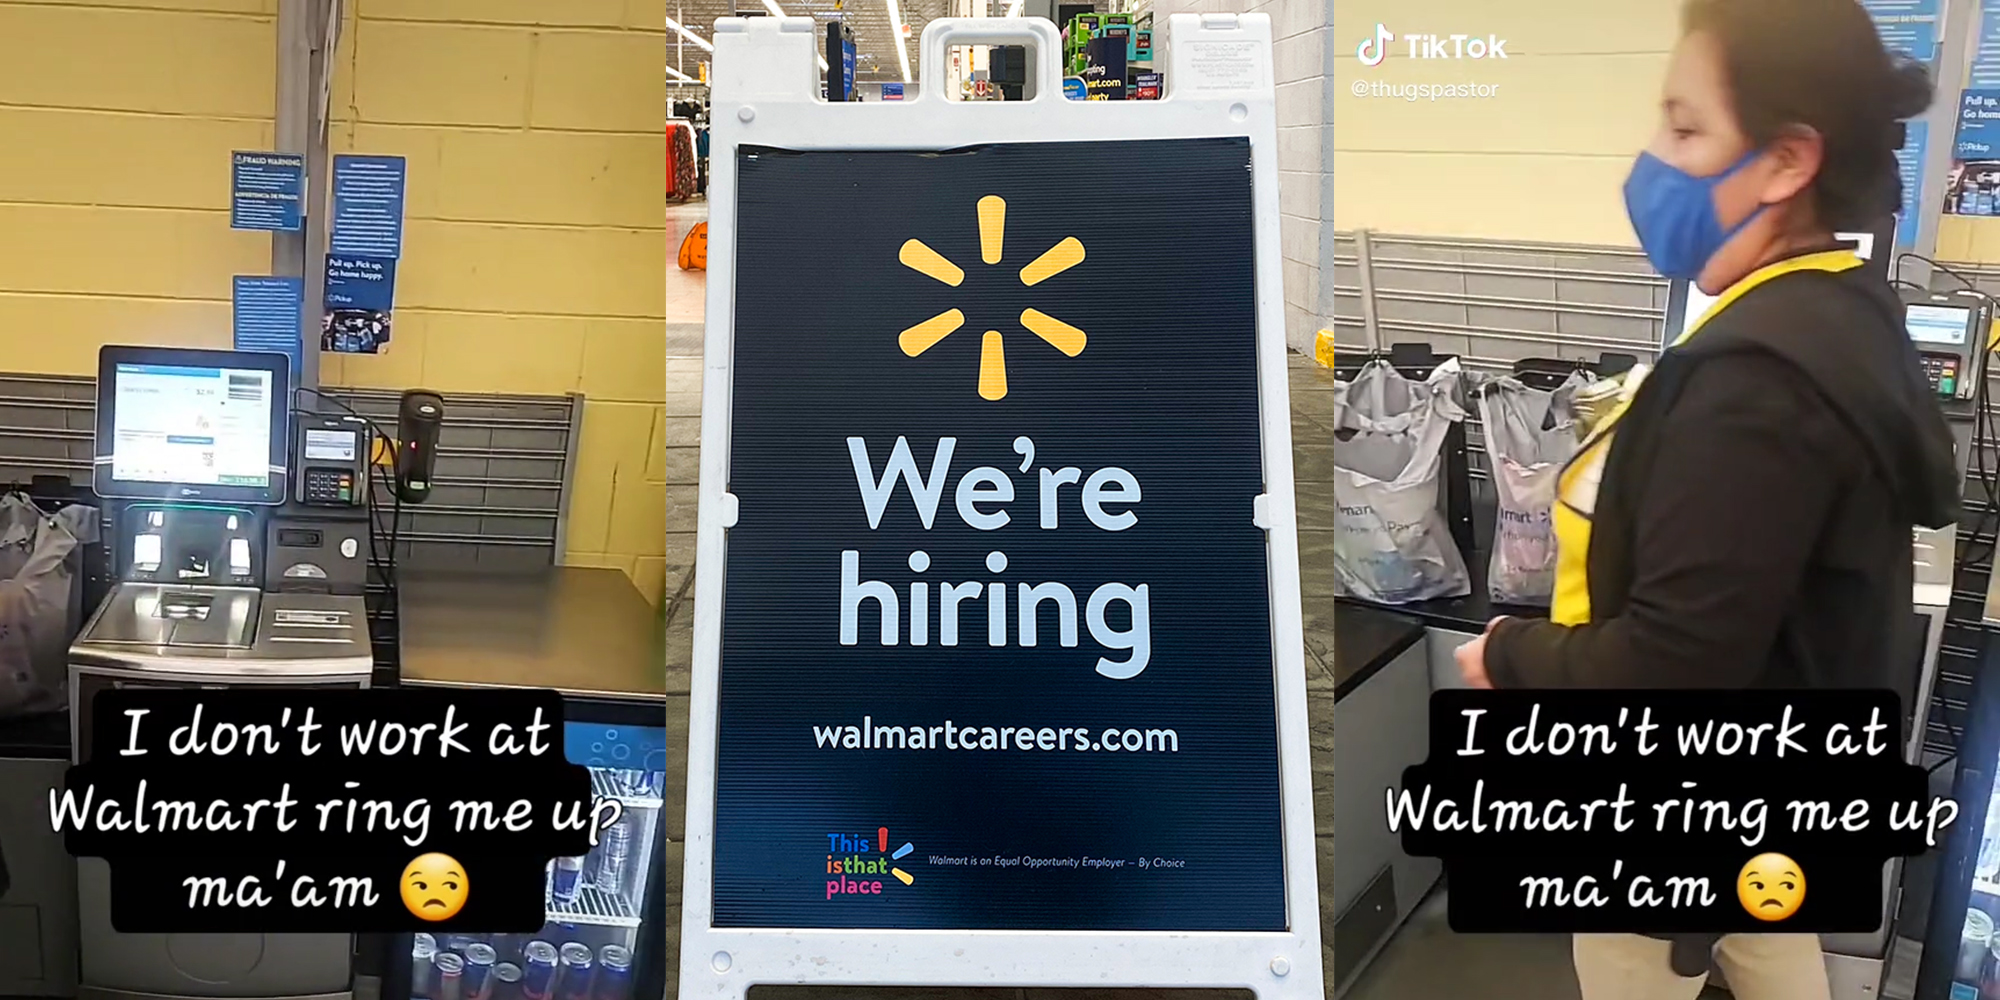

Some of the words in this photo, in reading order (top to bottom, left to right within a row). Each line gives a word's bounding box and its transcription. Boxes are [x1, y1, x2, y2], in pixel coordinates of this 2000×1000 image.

[1963, 109, 1977, 118] Go
[328, 268, 339, 277] Go
[846, 435, 1142, 531] We're
[839, 549, 1151, 680] hiring
[812, 715, 1179, 752] walmartcareers.com
[827, 833, 870, 853] This
[928, 855, 968, 867] Walmart
[970, 856, 978, 867] is
[979, 858, 992, 867] an
[994, 855, 1021, 869] Equal
[1022, 856, 1080, 870] Opportunity
[1082, 857, 1126, 870] Employer
[1138, 857, 1151, 870] By
[1152, 857, 1186, 869] Choice
[826, 875, 883, 900] place
